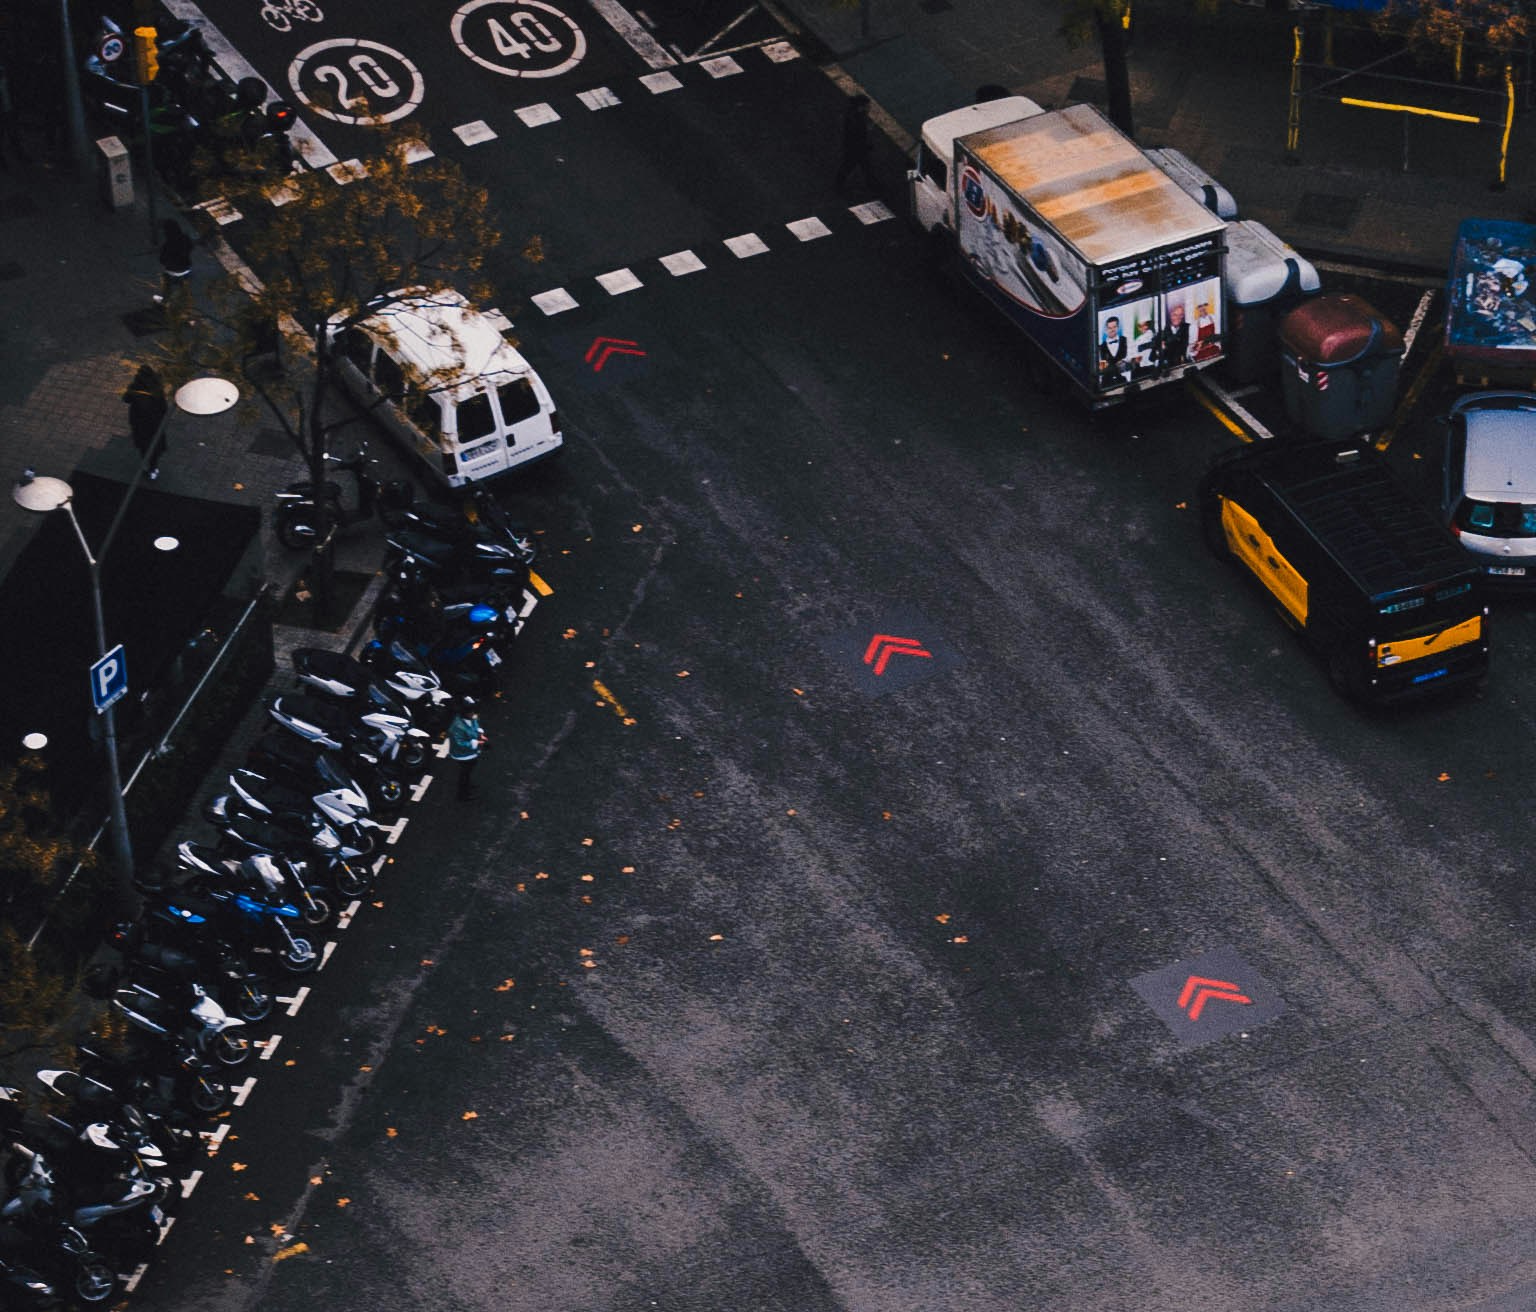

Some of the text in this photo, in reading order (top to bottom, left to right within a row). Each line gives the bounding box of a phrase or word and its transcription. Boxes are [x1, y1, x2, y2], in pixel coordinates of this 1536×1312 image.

[487, 11, 563, 59] 40
[314, 55, 400, 109] 20
[99, 658, 118, 697] P
